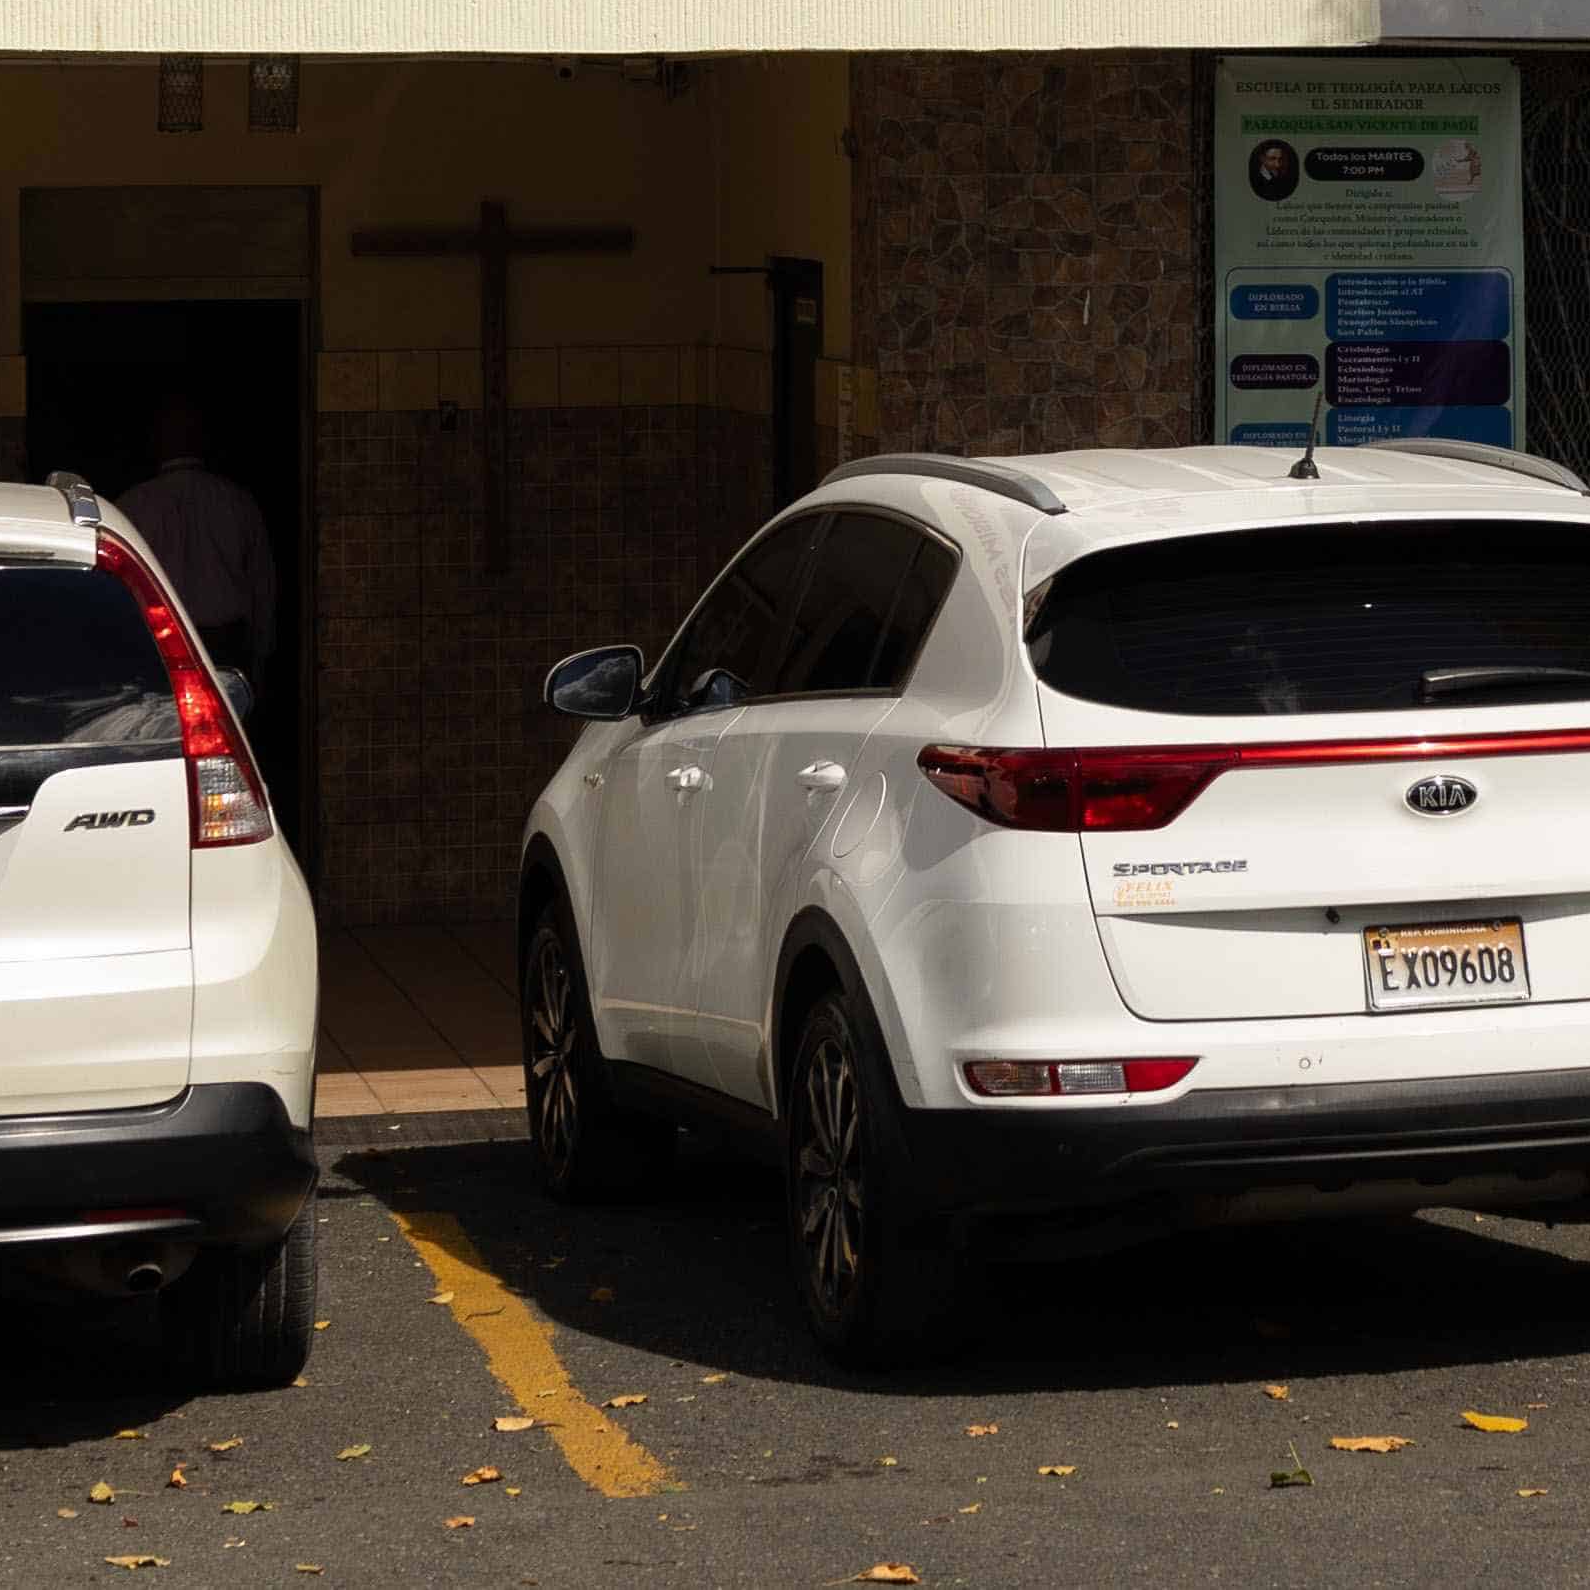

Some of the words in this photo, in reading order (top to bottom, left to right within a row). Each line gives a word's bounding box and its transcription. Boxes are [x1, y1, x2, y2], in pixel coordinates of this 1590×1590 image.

[1235, 81, 1300, 94] ESCUELA
[1306, 82, 1329, 94] DE
[1332, 79, 1403, 95] TEOLOGÍA
[1409, 82, 1444, 94] PARA
[1449, 82, 1501, 95] LAICOS
[1311, 98, 1329, 110] EL
[1333, 98, 1425, 110] SEMBRADOR
[1244, 118, 1325, 133] PARROQUIA
[1327, 119, 1354, 131] SAN
[1357, 119, 1416, 132] VICENTE
[1420, 119, 1439, 132] DE
[1316, 152, 1347, 162] Todos
[1350, 152, 1366, 162] los
[1368, 152, 1413, 162] MARTES
[1342, 166, 1365, 176] 7:00
[1368, 166, 1385, 175] PM
[1248, 293, 1305, 302] DIPLOMADO
[1269, 303, 1301, 312] BIBLIA
[1242, 363, 1293, 372] DIPLOMADO
[1294, 363, 1307, 372] EN
[1274, 372, 1317, 381] PASTORAL
[1419, 784, 1467, 807] KIA
[63, 809, 156, 832] AWD
[1113, 860, 1249, 877] SPORTAGE
[1378, 946, 1515, 991] EX09608
